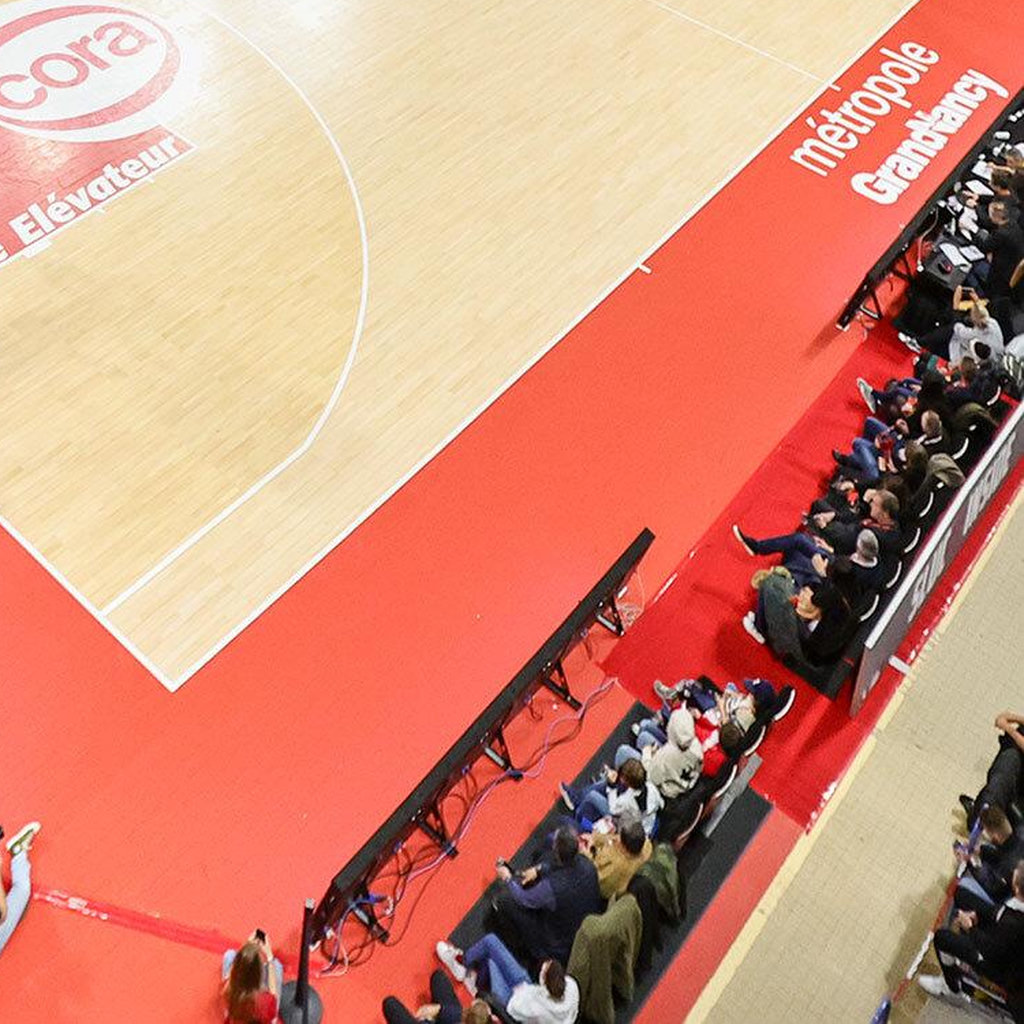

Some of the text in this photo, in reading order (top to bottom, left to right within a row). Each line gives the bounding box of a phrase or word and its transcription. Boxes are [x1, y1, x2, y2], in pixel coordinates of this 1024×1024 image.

[789, 41, 940, 177] métropole
[851, 68, 1010, 206] GrandNancy
[7, 135, 179, 247] Elévateur
